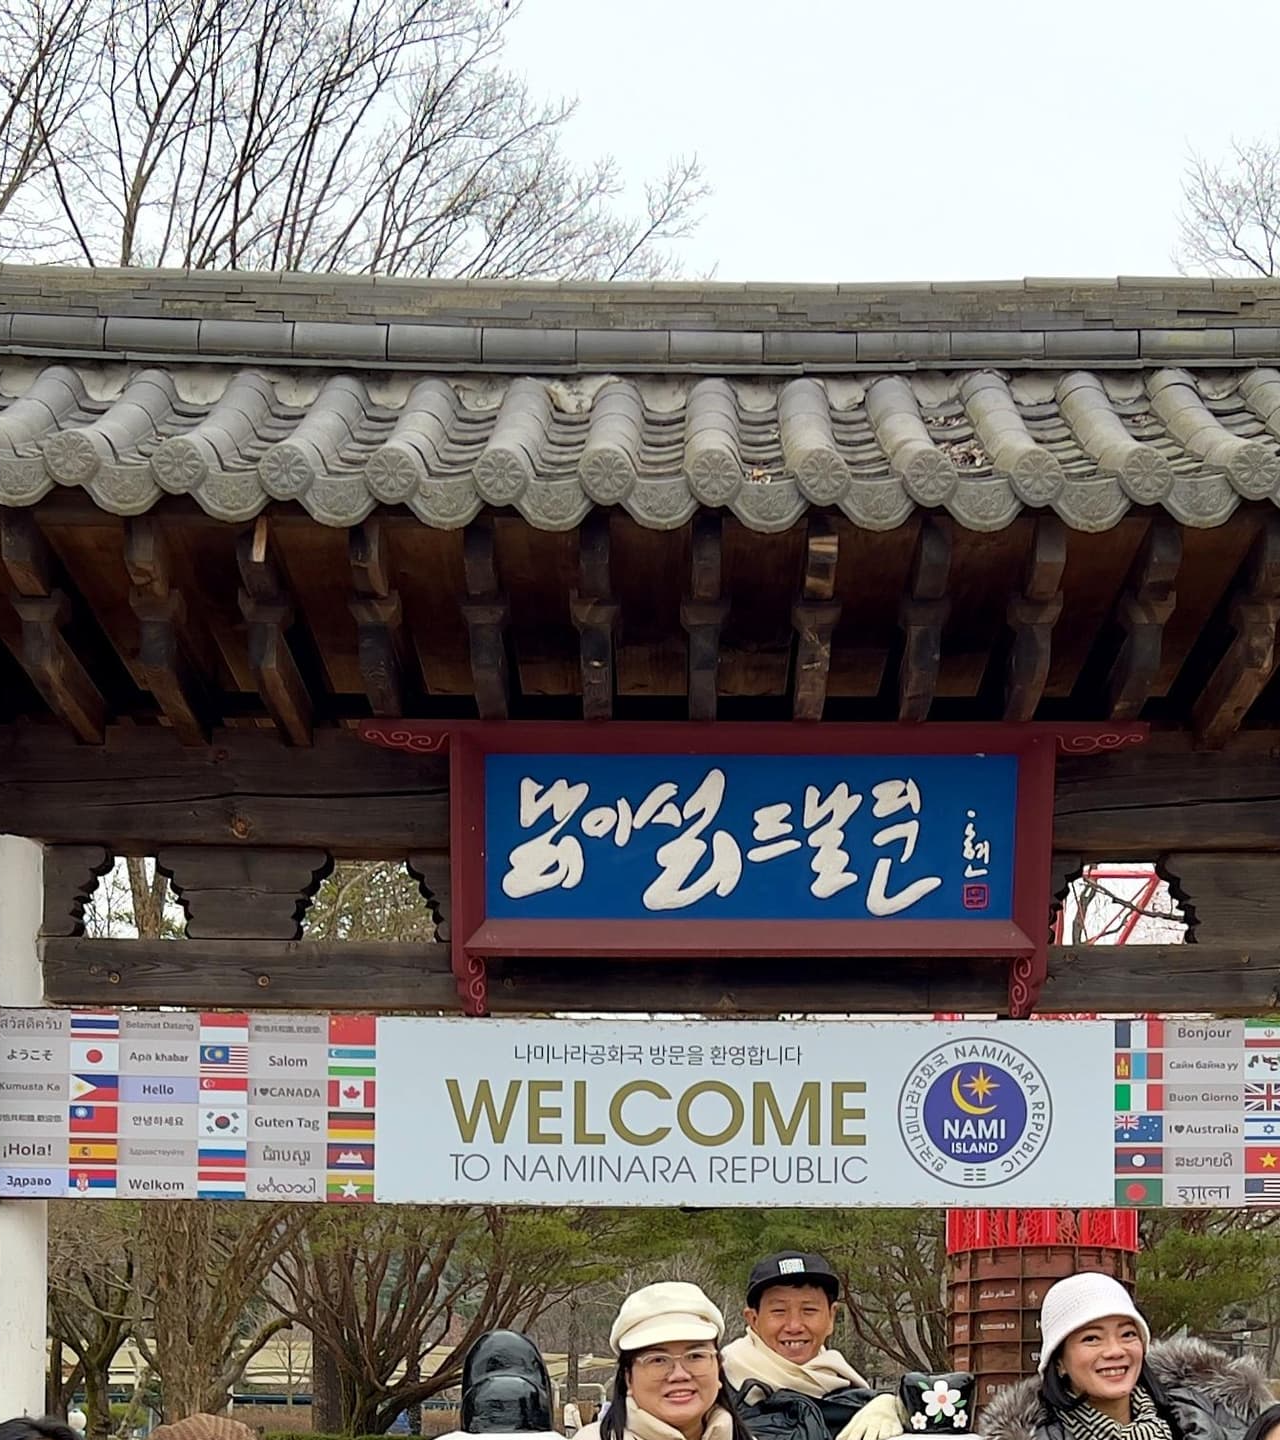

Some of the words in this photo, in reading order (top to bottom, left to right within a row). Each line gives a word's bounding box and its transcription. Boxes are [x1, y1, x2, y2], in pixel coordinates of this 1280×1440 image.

[1177, 1027, 1232, 1041] Bonjour
[6, 1048, 54, 1062] ようこそ
[129, 1051, 152, 1063] Apa
[268, 1055, 308, 1067] Salom
[513, 1044, 645, 1066] 나미나라공화국
[649, 1044, 705, 1066] 방문을
[709, 1045, 803, 1067] 환영합니다
[46, 1081, 61, 1091] Ka
[142, 1084, 175, 1095] Hello
[1169, 1093, 1198, 1102] Buon
[1201, 1093, 1239, 1102] Giorno
[445, 1079, 867, 1147] WELCOME
[953, 1044, 1040, 1096] NAMINARA
[1000, 1101, 1046, 1173] REPUBLIC
[132, 1115, 185, 1127] 안녕하세요
[254, 1116, 294, 1129] Guten
[297, 1117, 321, 1132] Tag
[943, 1119, 1006, 1140] NAMI
[1185, 1124, 1239, 1134] Australia
[3, 1143, 52, 1157] ¡Hola!
[951, 1142, 999, 1154] ISLAND
[450, 1153, 491, 1182] TO
[503, 1153, 698, 1184] NAMINARA
[709, 1155, 869, 1184] REPUBLIC
[6, 1175, 52, 1188] Здраво
[128, 1178, 185, 1191] Welkom
